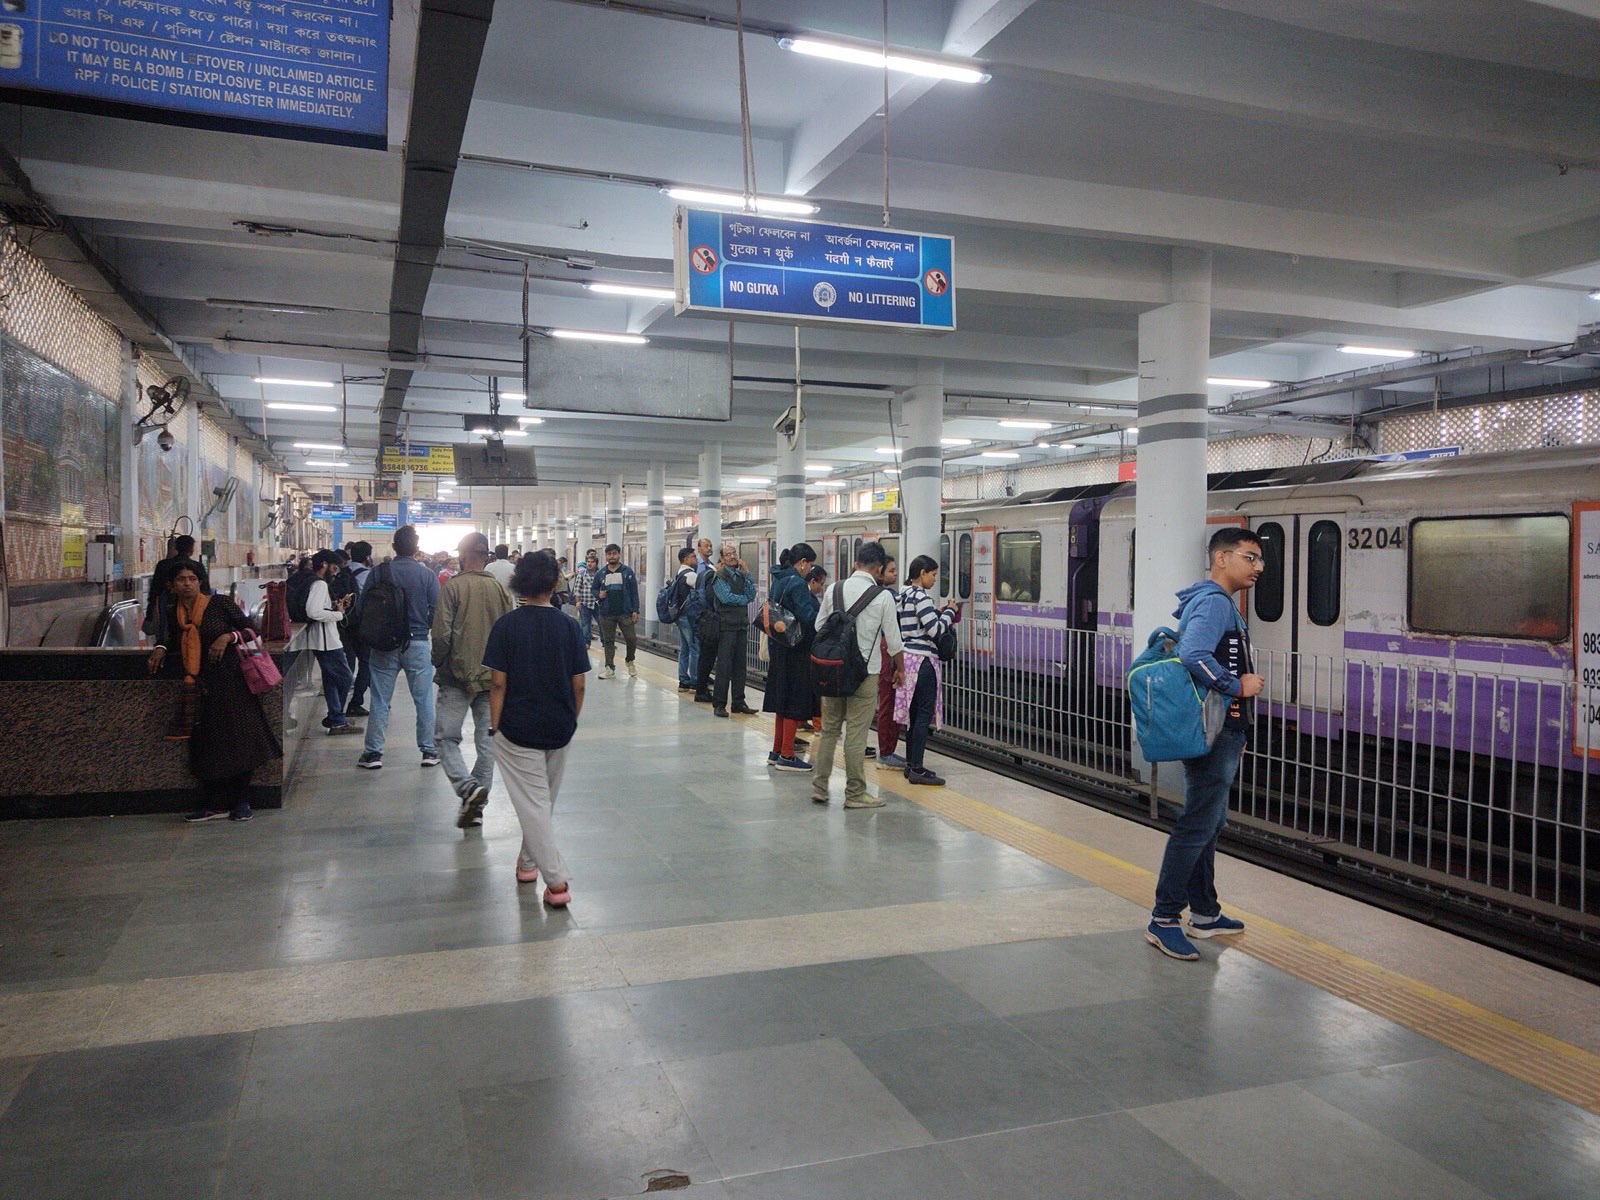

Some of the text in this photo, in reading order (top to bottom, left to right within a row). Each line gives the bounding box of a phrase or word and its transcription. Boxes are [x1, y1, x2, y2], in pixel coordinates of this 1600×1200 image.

[62, 6, 91, 20] আর
[97, 8, 113, 24] পি
[120, 16, 144, 28] এফ
[164, 22, 202, 39] পুলিশ
[188, 8, 217, 22] হতে
[266, 21, 288, 35] দয়া
[294, 26, 320, 40] করে
[292, 9, 333, 24] করবেন
[72, 35, 99, 49] NOT
[103, 39, 148, 56] TOUCH
[151, 48, 177, 61] ANY
[255, 64, 324, 84] UNCLAIMED
[326, 74, 377, 92] ARTICLE.
[67, 50, 78, 62] IT
[82, 53, 109, 68] MAY
[113, 58, 130, 71] BE
[134, 61, 144, 73] A
[147, 63, 184, 79] BOMB
[195, 71, 265, 91] EXPLOSIVE.
[268, 82, 314, 98] PLEASE
[318, 88, 362, 104] INFORM
[75, 68, 100, 82] RPF
[112, 74, 159, 92] POLICE
[169, 82, 220, 100] STATION
[224, 90, 274, 108] MASTER
[277, 98, 355, 119] IMMEDIATELY.
[759, 227, 796, 240] ফেলবেন
[800, 231, 810, 242] না
[824, 234, 914, 253] আবর্জনা ফেলবেন না
[729, 244, 758, 257] गुटका
[763, 247, 770, 256] न
[824, 251, 850, 264] गंदगी
[854, 256, 862, 266] न
[729, 280, 779, 296] NO GUTKA
[848, 292, 863, 304] NO
[866, 293, 916, 308] LITTERING
[1348, 526, 1402, 549] 3204
